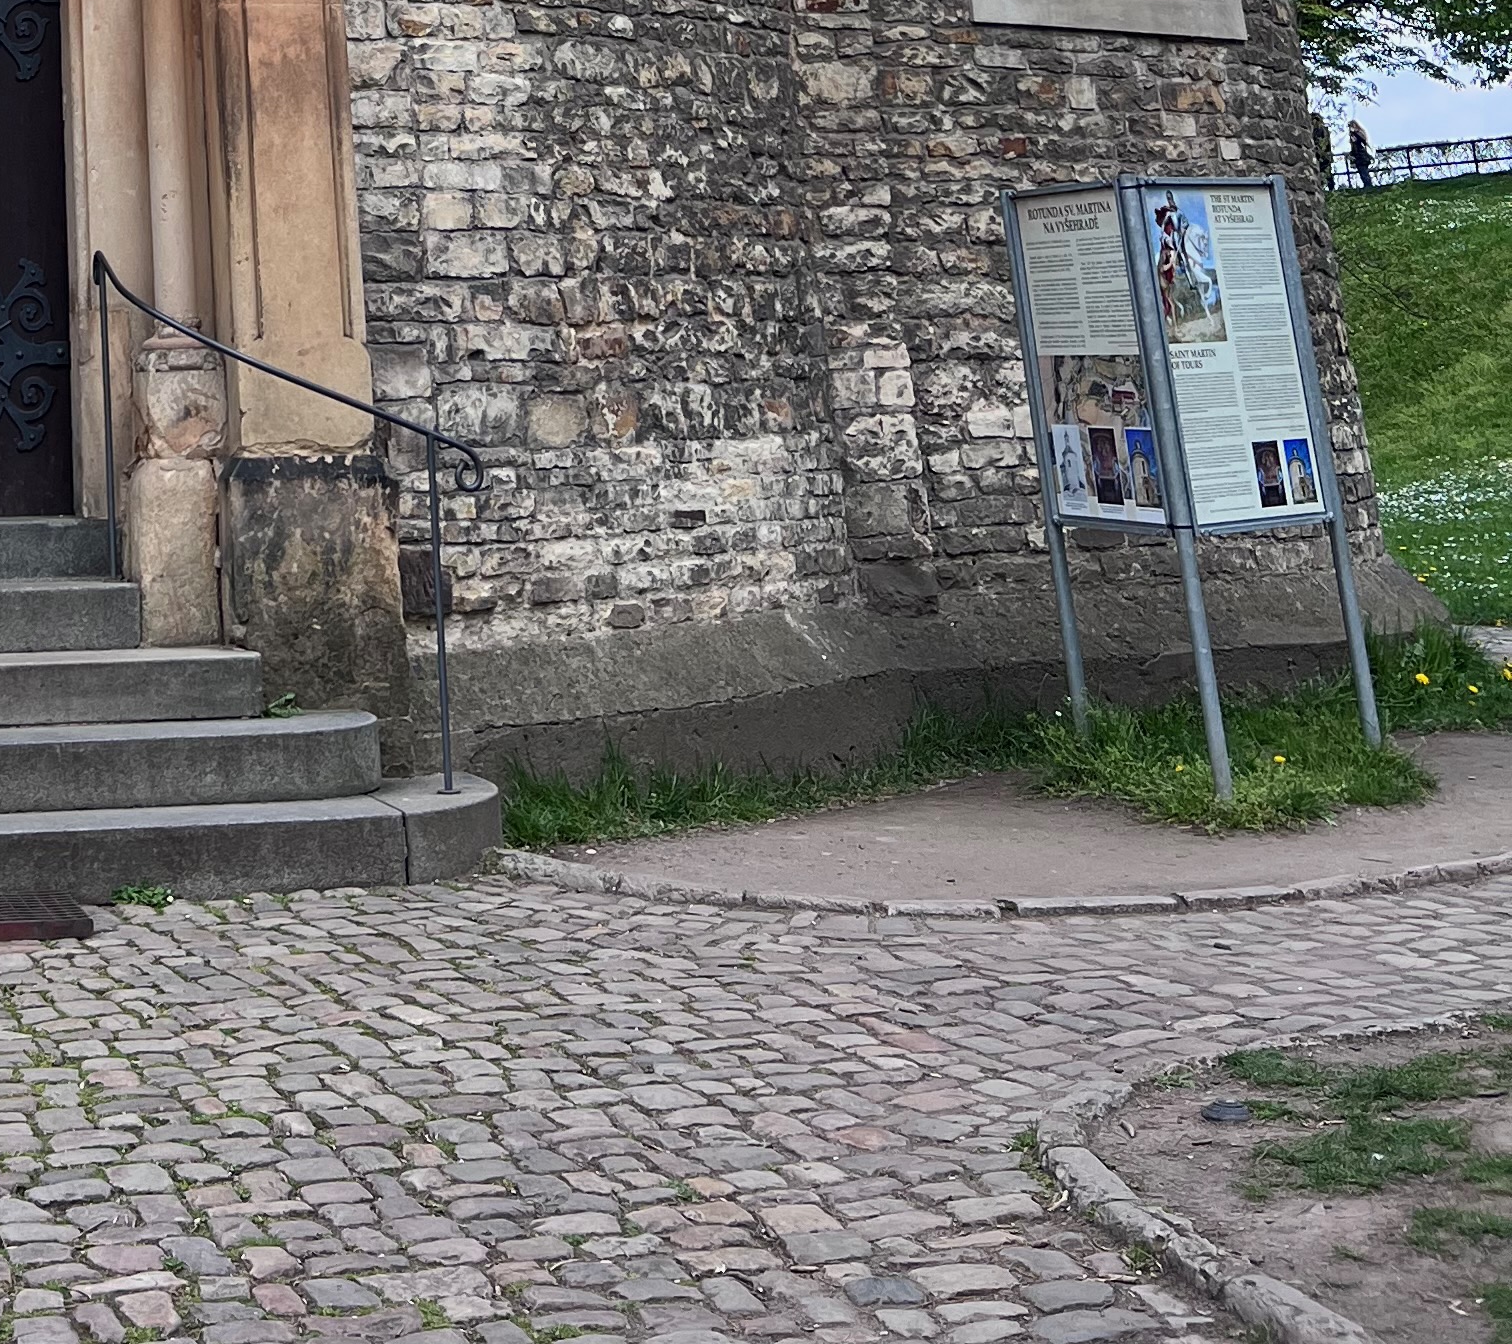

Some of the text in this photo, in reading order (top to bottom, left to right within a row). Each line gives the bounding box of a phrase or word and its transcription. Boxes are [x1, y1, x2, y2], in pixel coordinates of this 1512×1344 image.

[1209, 194, 1223, 203] THE
[1231, 194, 1255, 204] MARTIN
[1027, 206, 1064, 221] ROTUNDA
[1076, 200, 1112, 216] MARTINA
[1212, 204, 1242, 213] ROTUNDA
[1043, 215, 1100, 234] NA VYŠEHRADĚ
[1169, 348, 1217, 359] SAINT MARTIN
[1181, 359, 1204, 370] TOURS
